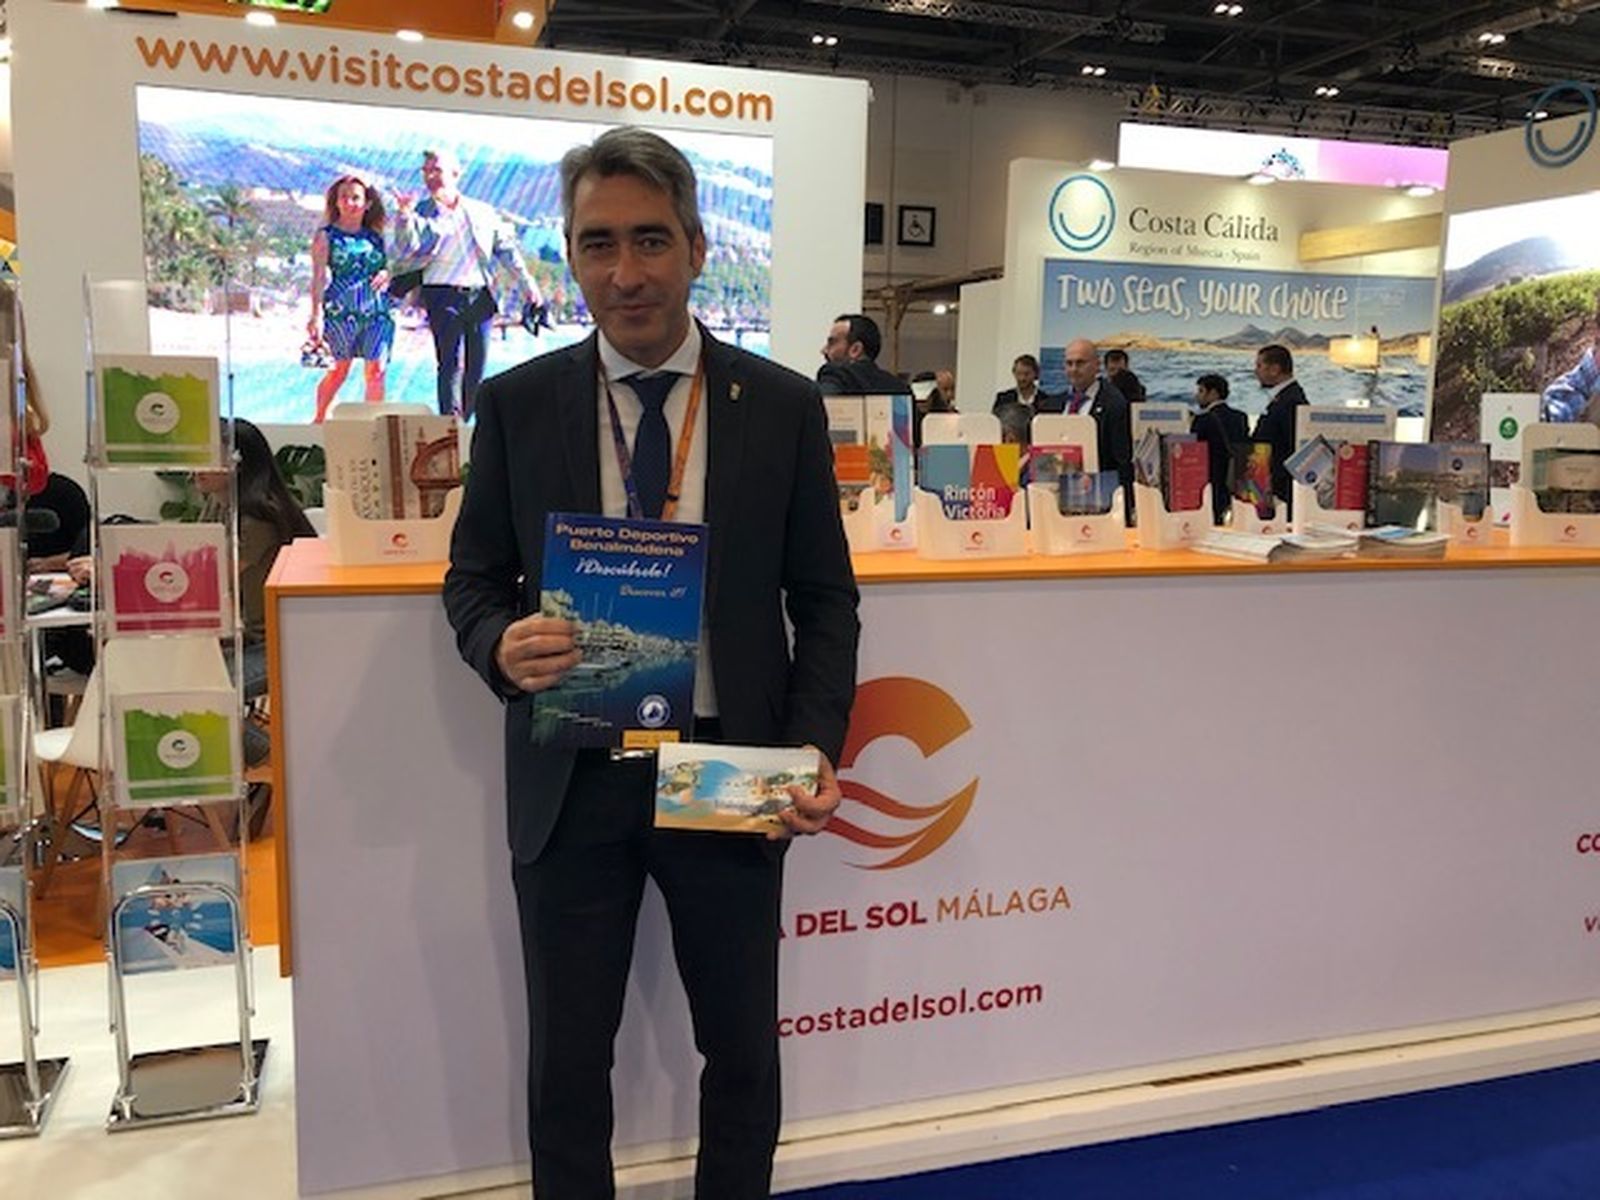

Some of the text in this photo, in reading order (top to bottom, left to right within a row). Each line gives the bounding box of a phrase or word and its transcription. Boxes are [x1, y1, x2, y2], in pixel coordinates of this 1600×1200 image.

[136, 35, 773, 121] www.visitcostadelsol.com
[1129, 206, 1279, 242] Costa Cálida
[944, 482, 995, 501] Rincón
[945, 502, 1006, 519] Victoria
[555, 522, 699, 544] Puerto Deportivo
[569, 538, 684, 557] Benalmádena
[796, 910, 857, 937] DEL
[866, 901, 927, 929] SOL
[936, 886, 1071, 922] MÁLAGA
[776, 983, 1043, 1037] costadelsol.com
